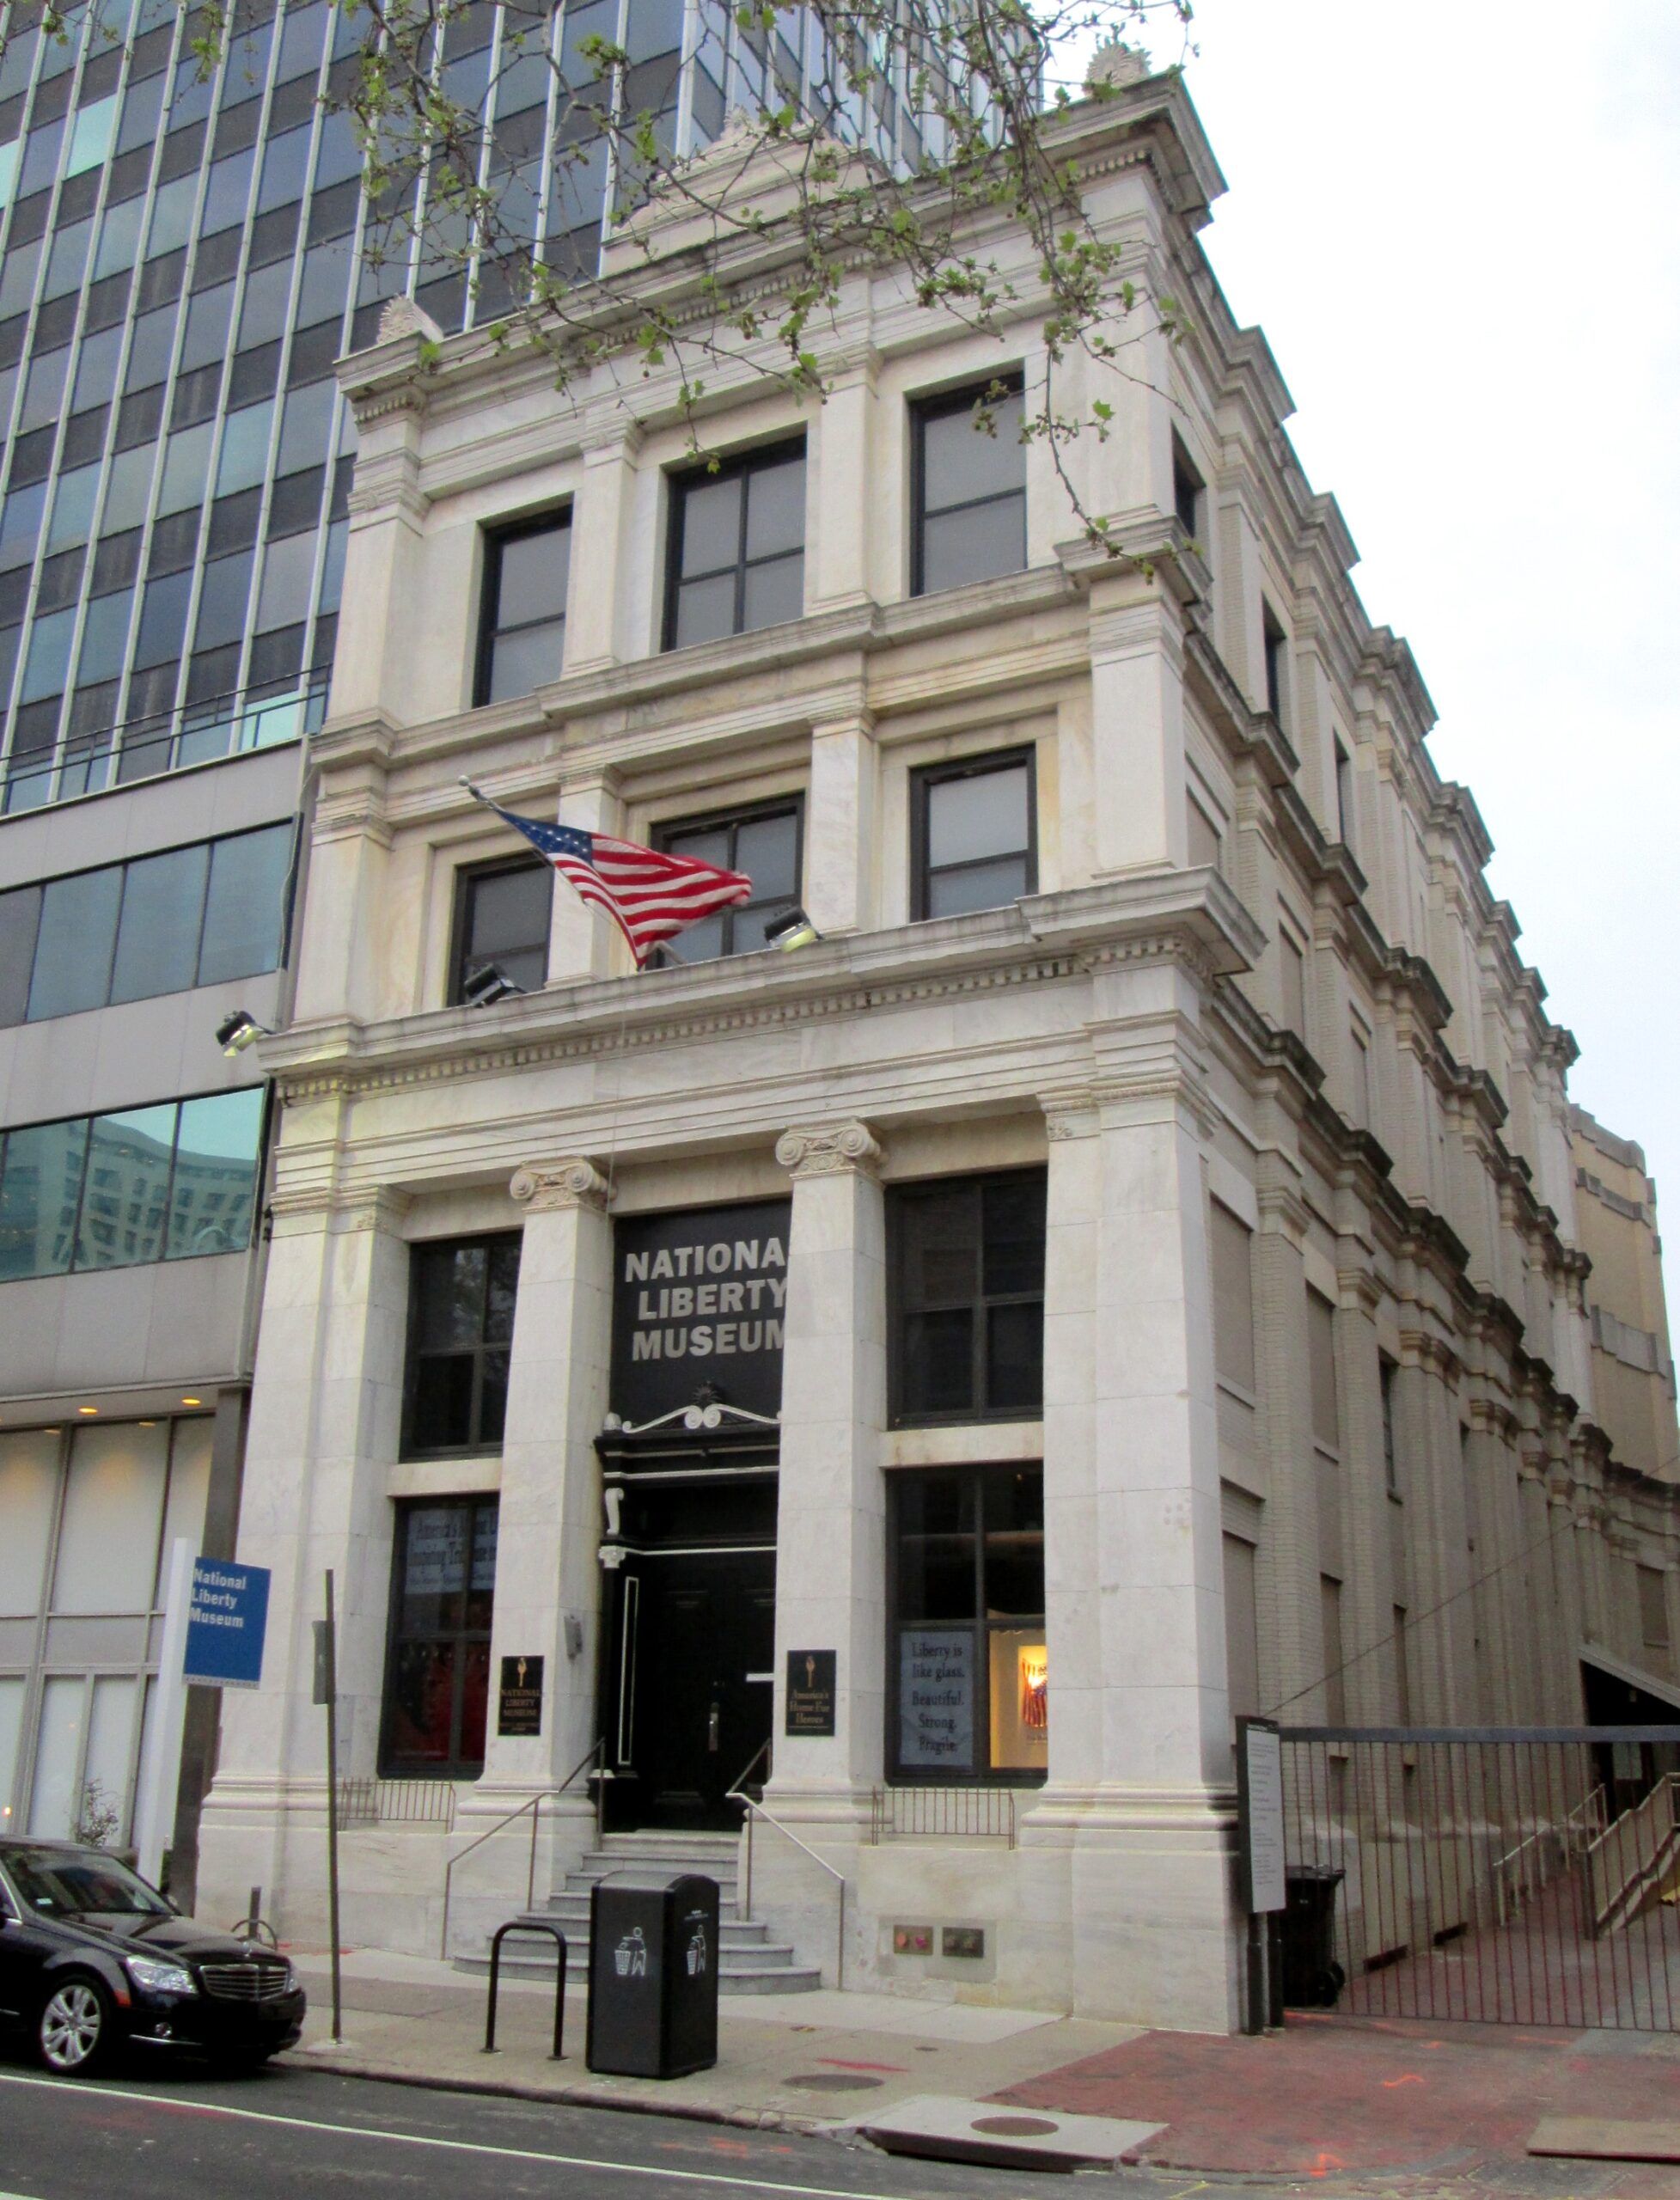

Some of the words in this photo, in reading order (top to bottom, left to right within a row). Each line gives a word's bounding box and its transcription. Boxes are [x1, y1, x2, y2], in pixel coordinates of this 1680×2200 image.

[638, 1277, 787, 1321] LIBERTY
[632, 1318, 785, 1361] MUSEUM
[193, 1568, 247, 1589] National
[192, 1587, 238, 1610] Liberty
[189, 1607, 243, 1628] Museum
[911, 1642, 950, 1659] Liberty
[953, 1643, 962, 1656] is
[913, 1664, 932, 1678] like
[501, 1689, 541, 1697] NATIONAL
[505, 1698, 535, 1708] LIBERTY
